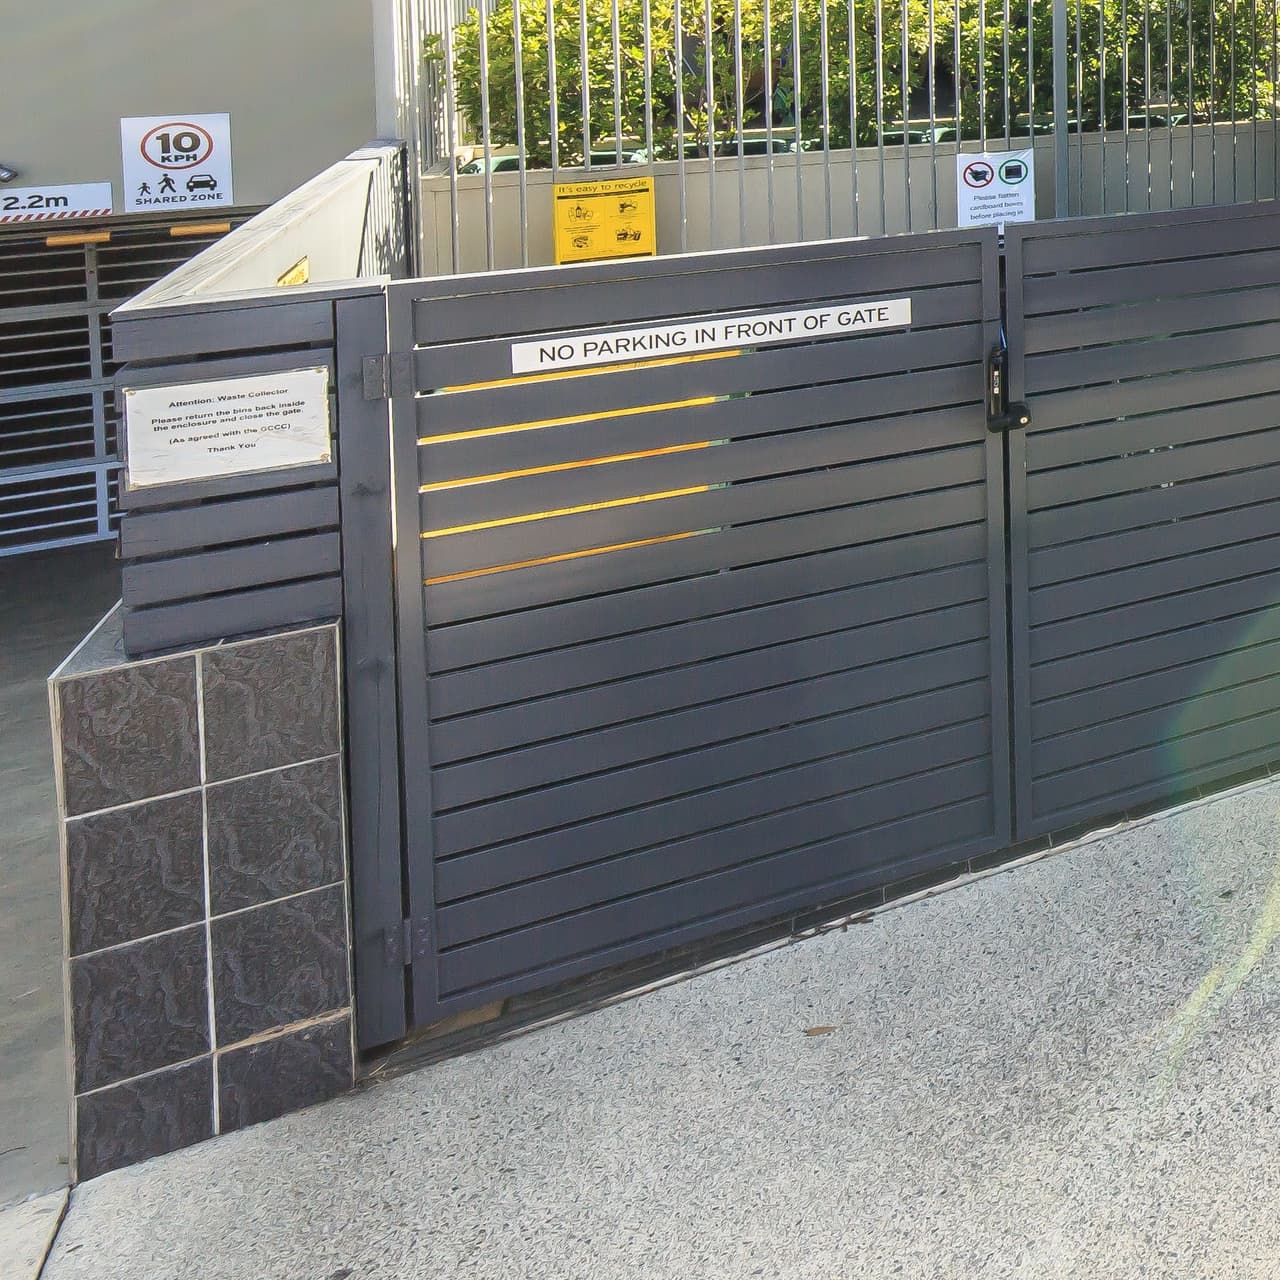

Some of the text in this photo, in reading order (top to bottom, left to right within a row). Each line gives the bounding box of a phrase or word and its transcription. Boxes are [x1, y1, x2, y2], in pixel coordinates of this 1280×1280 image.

[156, 132, 201, 154] 10
[161, 154, 198, 163] KPH
[615, 180, 647, 189] recycle
[3, 195, 68, 210] 2.2m
[136, 193, 224, 206] SHARED ZONE
[539, 307, 889, 363] NO PARKING IN FRONT OF GATE
[169, 388, 289, 408] Attention: Waste Collector
[151, 416, 183, 424] Please
[185, 412, 214, 421] return
[233, 407, 252, 415] bins
[255, 403, 276, 412] back
[279, 400, 305, 409] inside
[153, 424, 169, 432] the
[171, 419, 217, 430] enclosure
[220, 416, 237, 424] and
[282, 408, 304, 416] gate.
[169, 437, 185, 445] (As
[188, 433, 219, 442] agreed
[222, 430, 241, 438] with
[208, 442, 257, 453] Thank You
